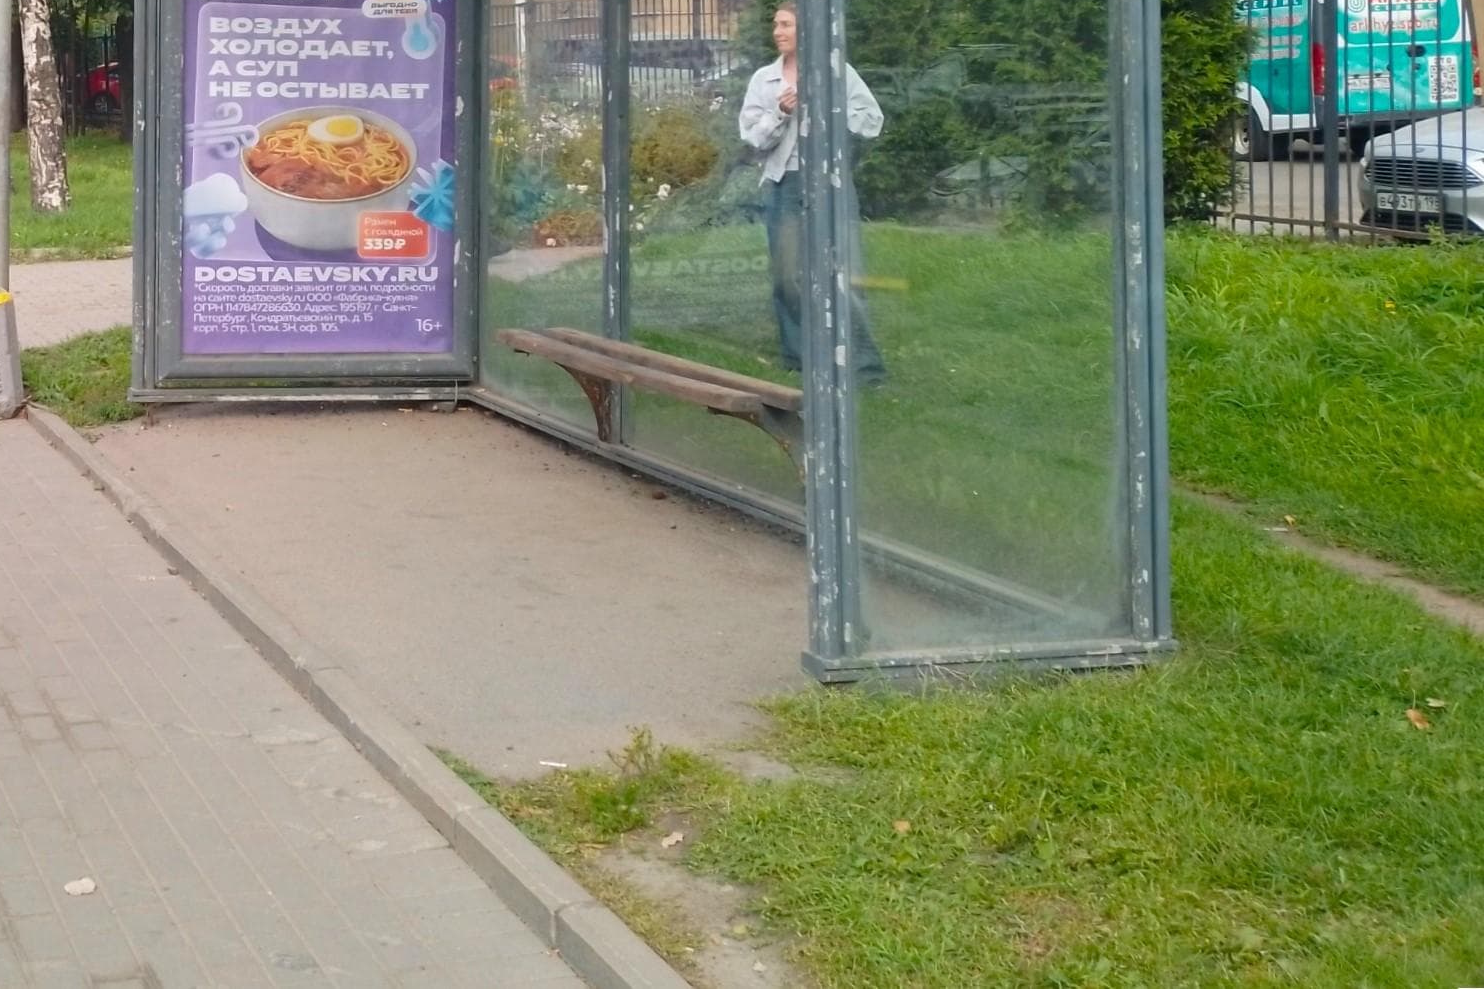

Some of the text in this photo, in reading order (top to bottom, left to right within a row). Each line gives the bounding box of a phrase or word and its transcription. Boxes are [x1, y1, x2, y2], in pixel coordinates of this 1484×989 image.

[371, 1, 419, 9] ВЫГОДНО
[210, 17, 342, 38] ВОЗДУХ
[209, 39, 394, 60] ХОЛОДАЕТ,
[208, 61, 298, 77] А СУП
[209, 82, 429, 99] НЕ ОСТЫВАЕТ
[195, 266, 439, 282] DOSTAEVSKY.RU
[307, 293, 332, 302] ООО
[194, 303, 223, 312] ОГРН
[415, 318, 443, 331] 16+
